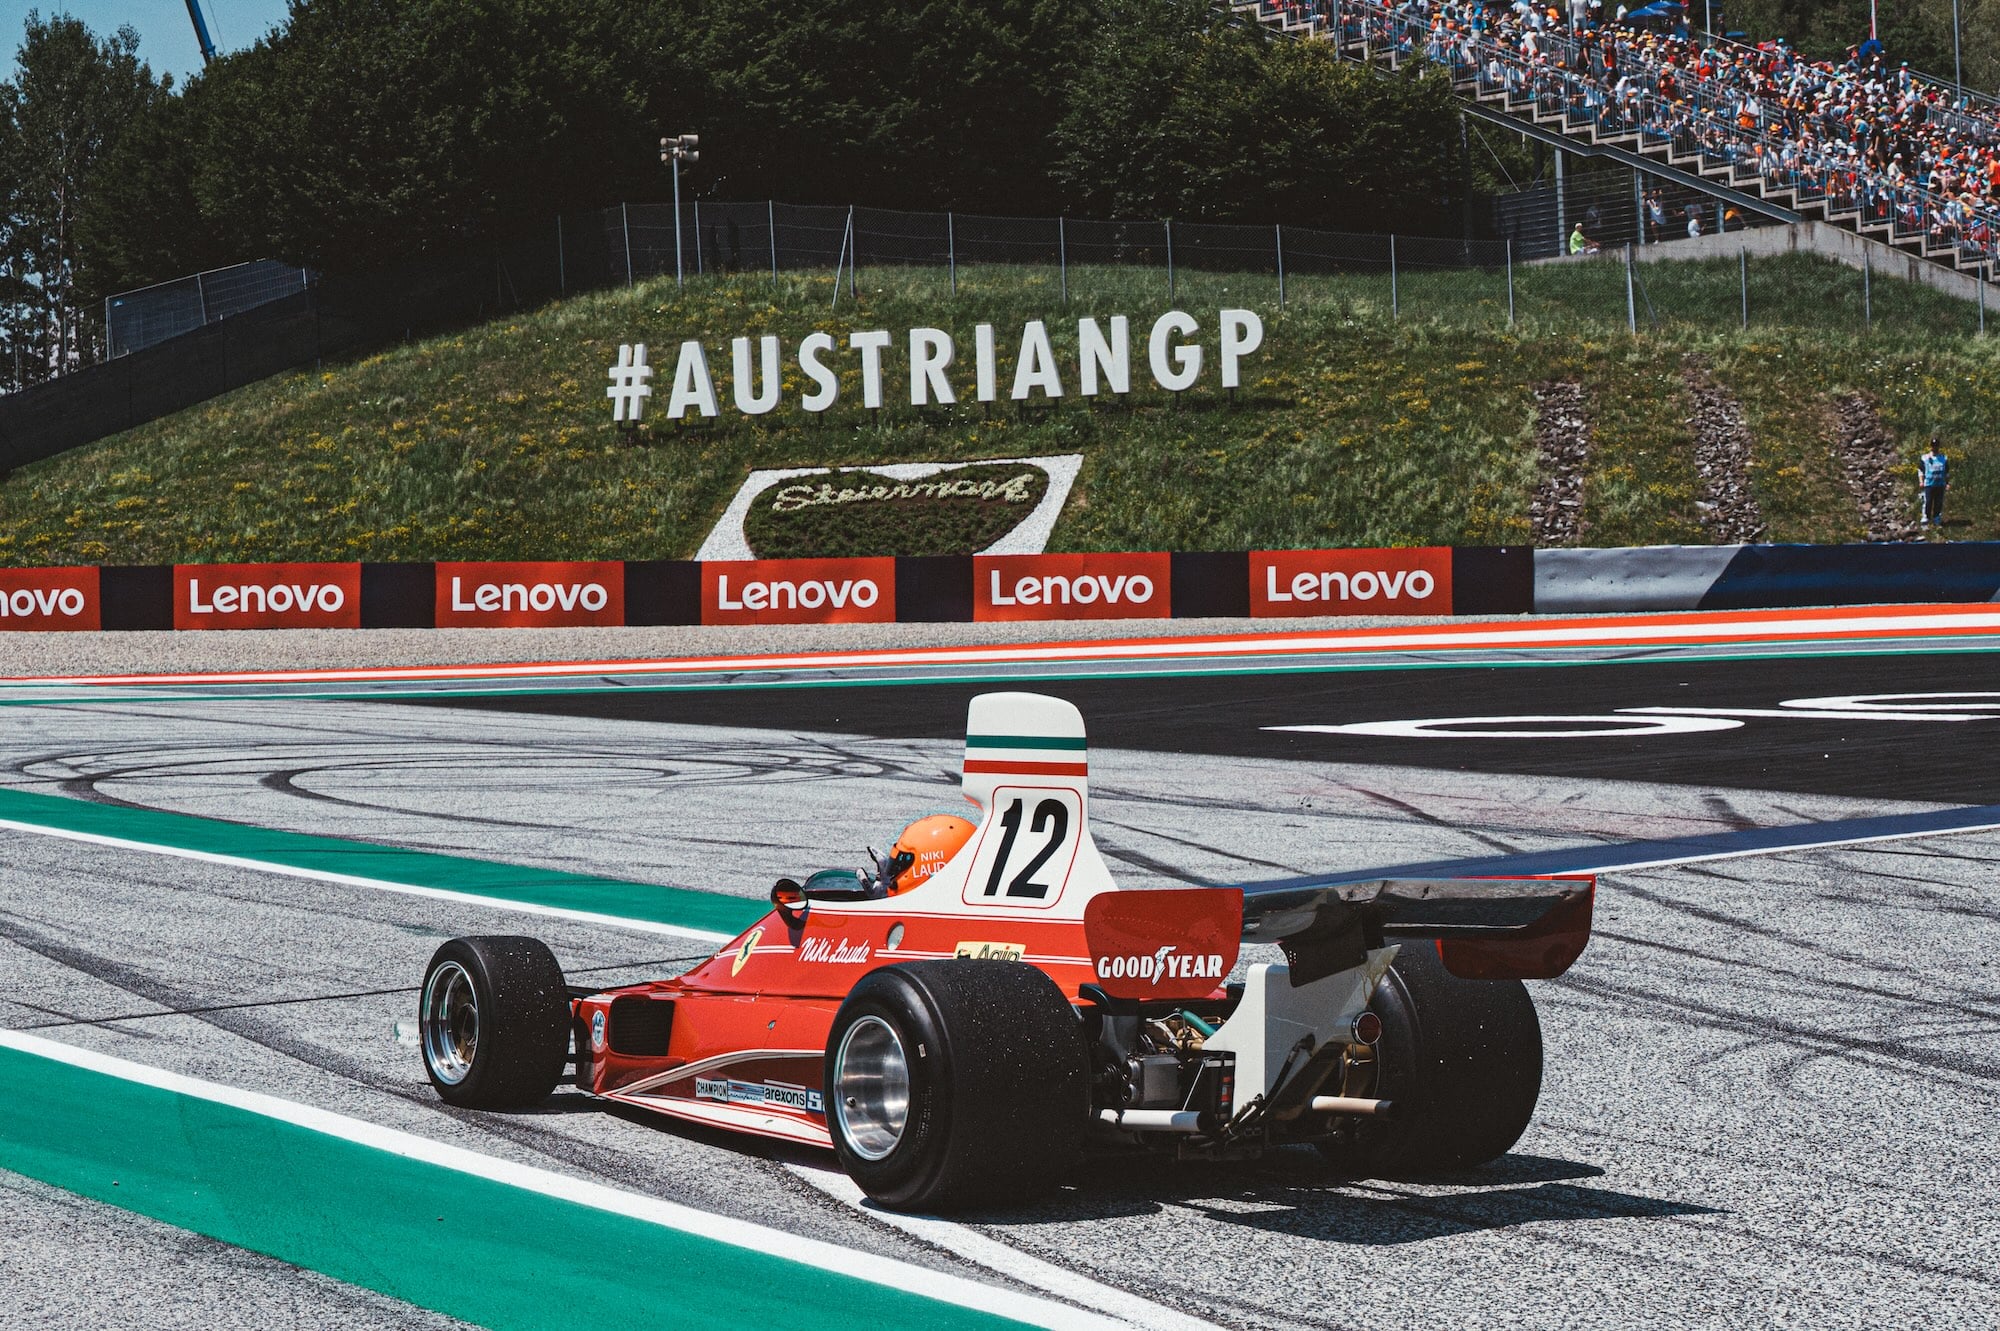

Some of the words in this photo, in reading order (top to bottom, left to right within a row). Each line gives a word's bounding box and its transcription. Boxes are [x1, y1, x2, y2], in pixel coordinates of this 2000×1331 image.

[607, 309, 1263, 421] #AUSTRIANGP
[772, 474, 1034, 511] Steiermark
[190, 579, 344, 613] Lenovo
[452, 577, 607, 612] Lenovo
[719, 574, 879, 610] Lenovo
[991, 570, 1154, 605] Lenovo
[1267, 566, 1435, 602] Lenovo
[920, 850, 945, 862] NIKI
[983, 798, 1069, 899] 12
[912, 861, 946, 879] LAUD
[798, 936, 834, 962] Niki
[828, 937, 871, 964] Lauda
[696, 1081, 727, 1097] CHAMPION
[764, 1087, 806, 1106] arexons
